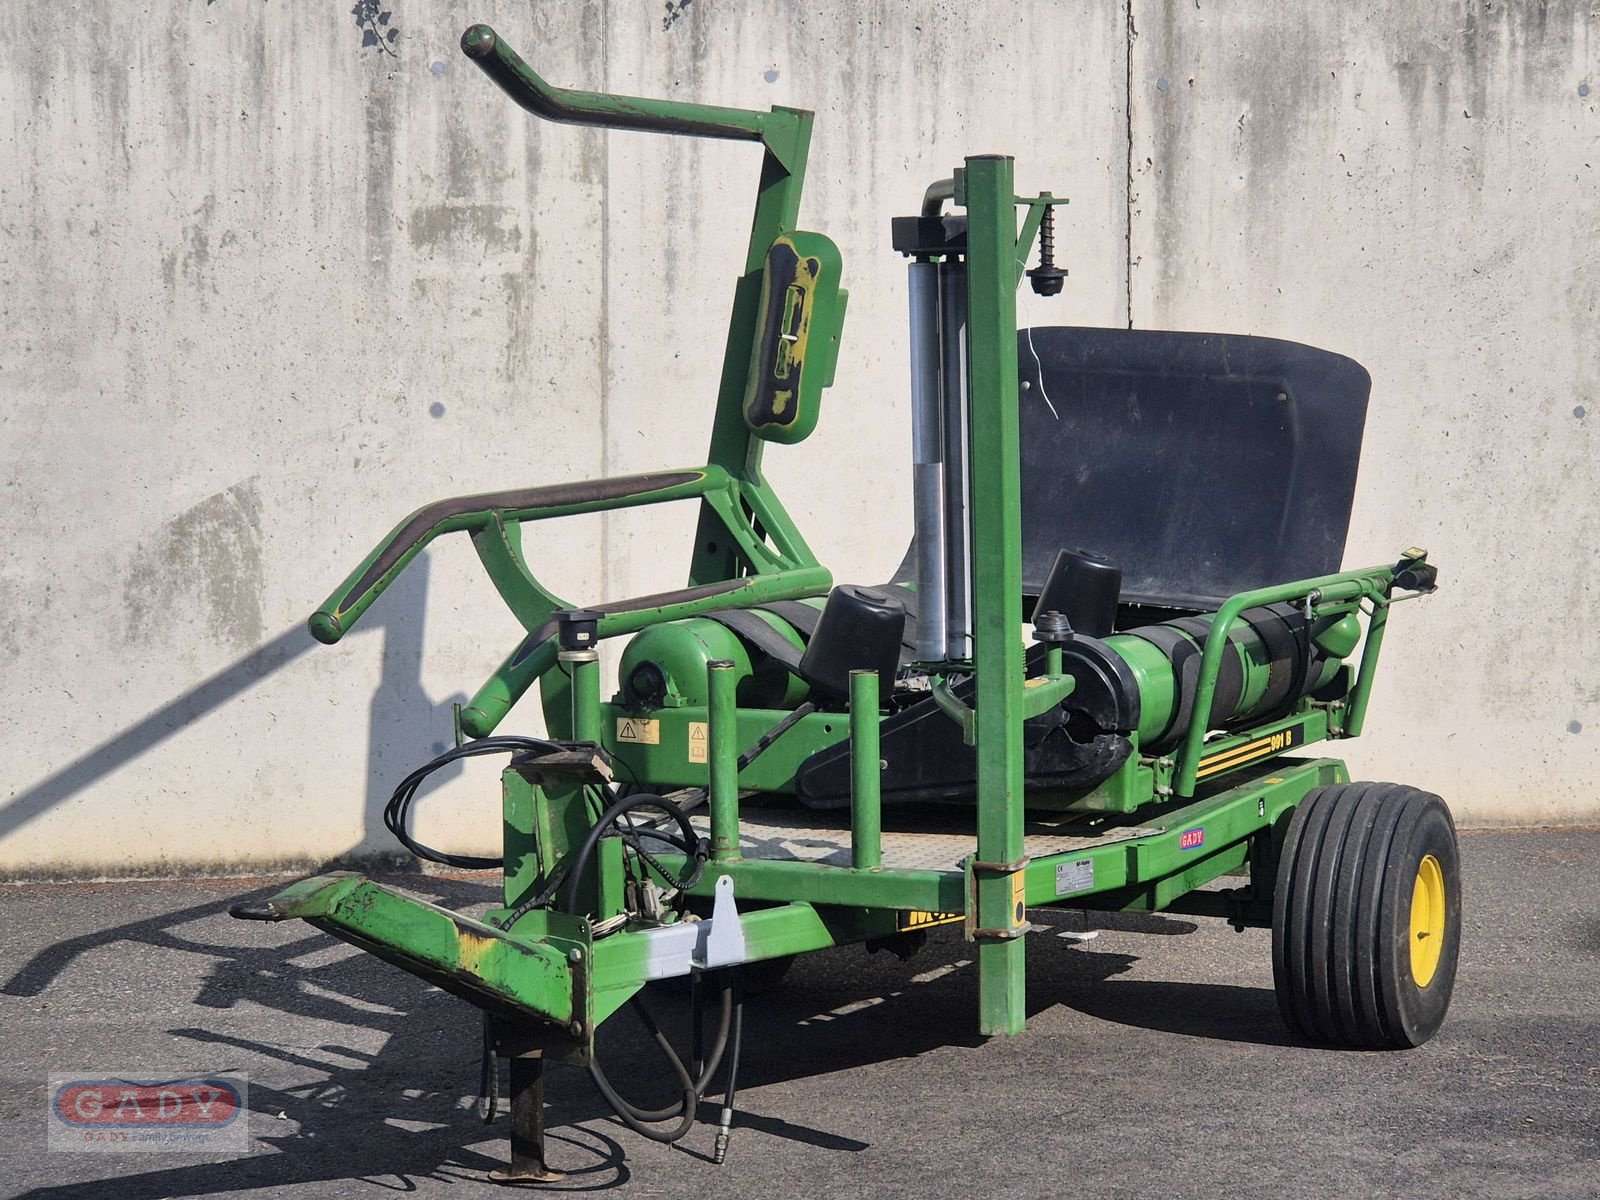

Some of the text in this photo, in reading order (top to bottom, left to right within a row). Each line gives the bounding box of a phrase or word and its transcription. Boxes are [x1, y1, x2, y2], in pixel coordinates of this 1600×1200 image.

[1271, 730, 1292, 752] 991 B
[1182, 831, 1202, 847] GADY
